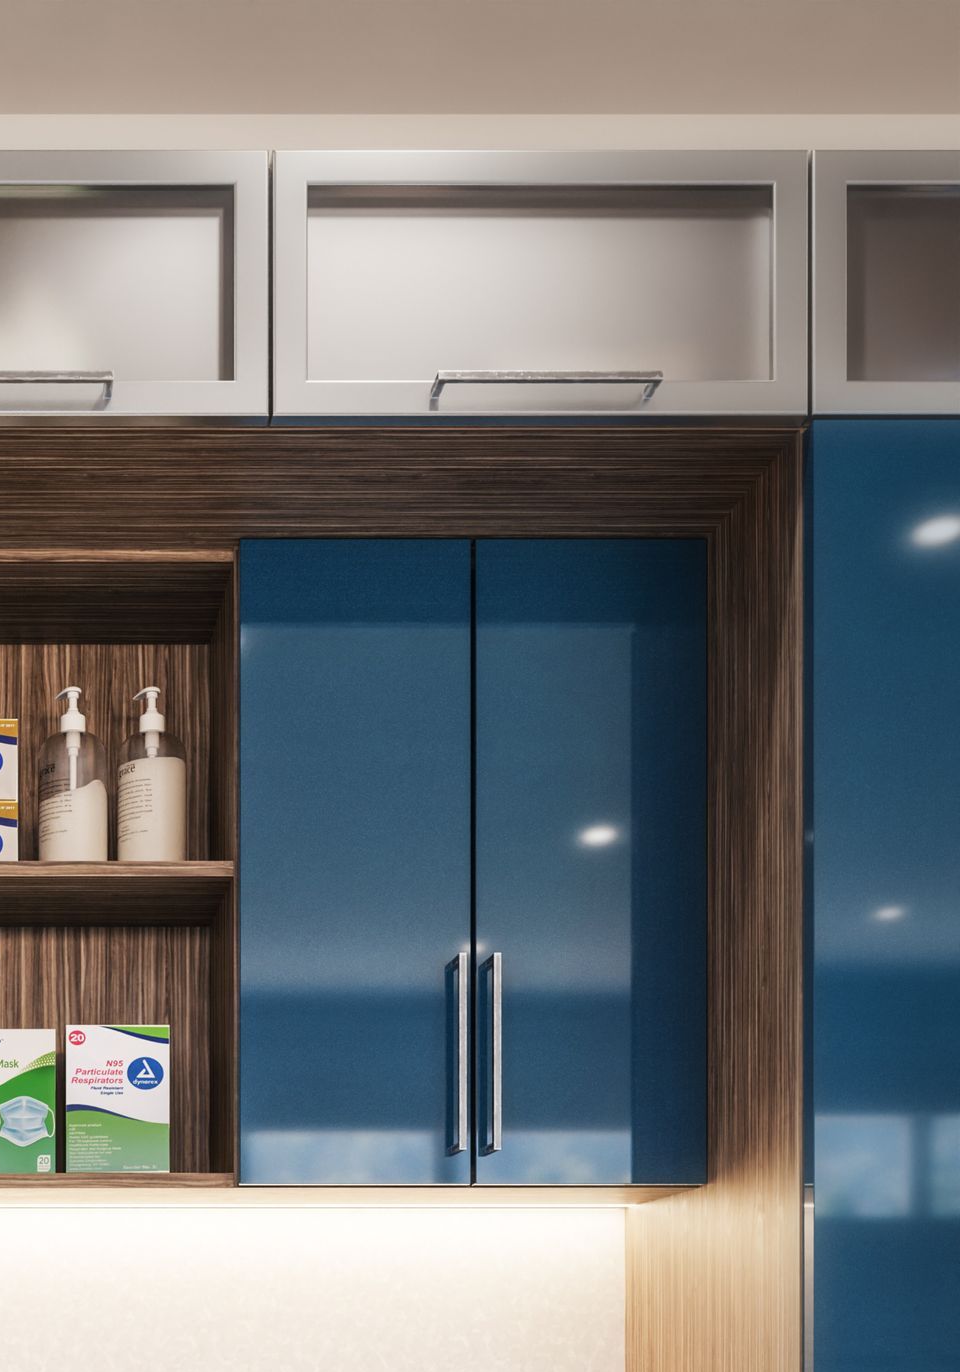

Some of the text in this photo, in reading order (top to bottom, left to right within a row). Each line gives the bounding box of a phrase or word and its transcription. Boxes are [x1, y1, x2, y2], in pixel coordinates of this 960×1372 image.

[70, 1033, 85, 1043] 20
[71, 1077, 124, 1085] Respirators
[39, 1156, 50, 1165] 20
